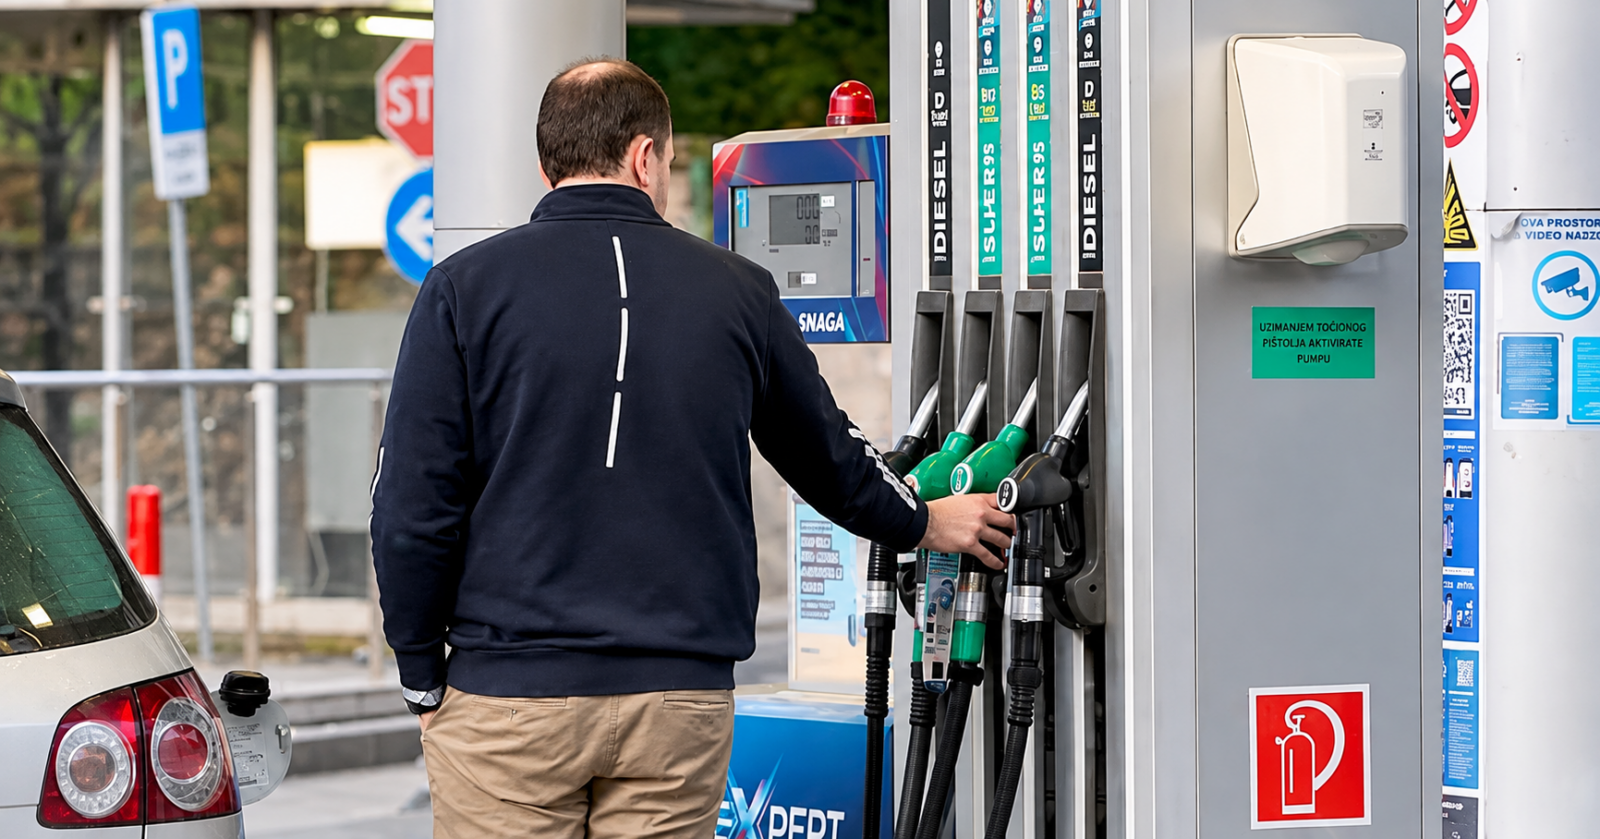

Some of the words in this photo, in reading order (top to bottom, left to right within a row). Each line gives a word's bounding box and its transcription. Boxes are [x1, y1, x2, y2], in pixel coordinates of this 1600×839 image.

[162, 28, 188, 110] P
[933, 141, 947, 253] DIESEL
[1083, 134, 1097, 251] DIESEL
[1525, 231, 1562, 240] VIDEO
[798, 311, 846, 332] SNAGA
[1259, 322, 1314, 332] UZIMANJEM
[1262, 336, 1306, 348] PIŠTOLJA
[1308, 338, 1363, 348] AKTIVIRATE
[1297, 354, 1331, 364] PUMPU
